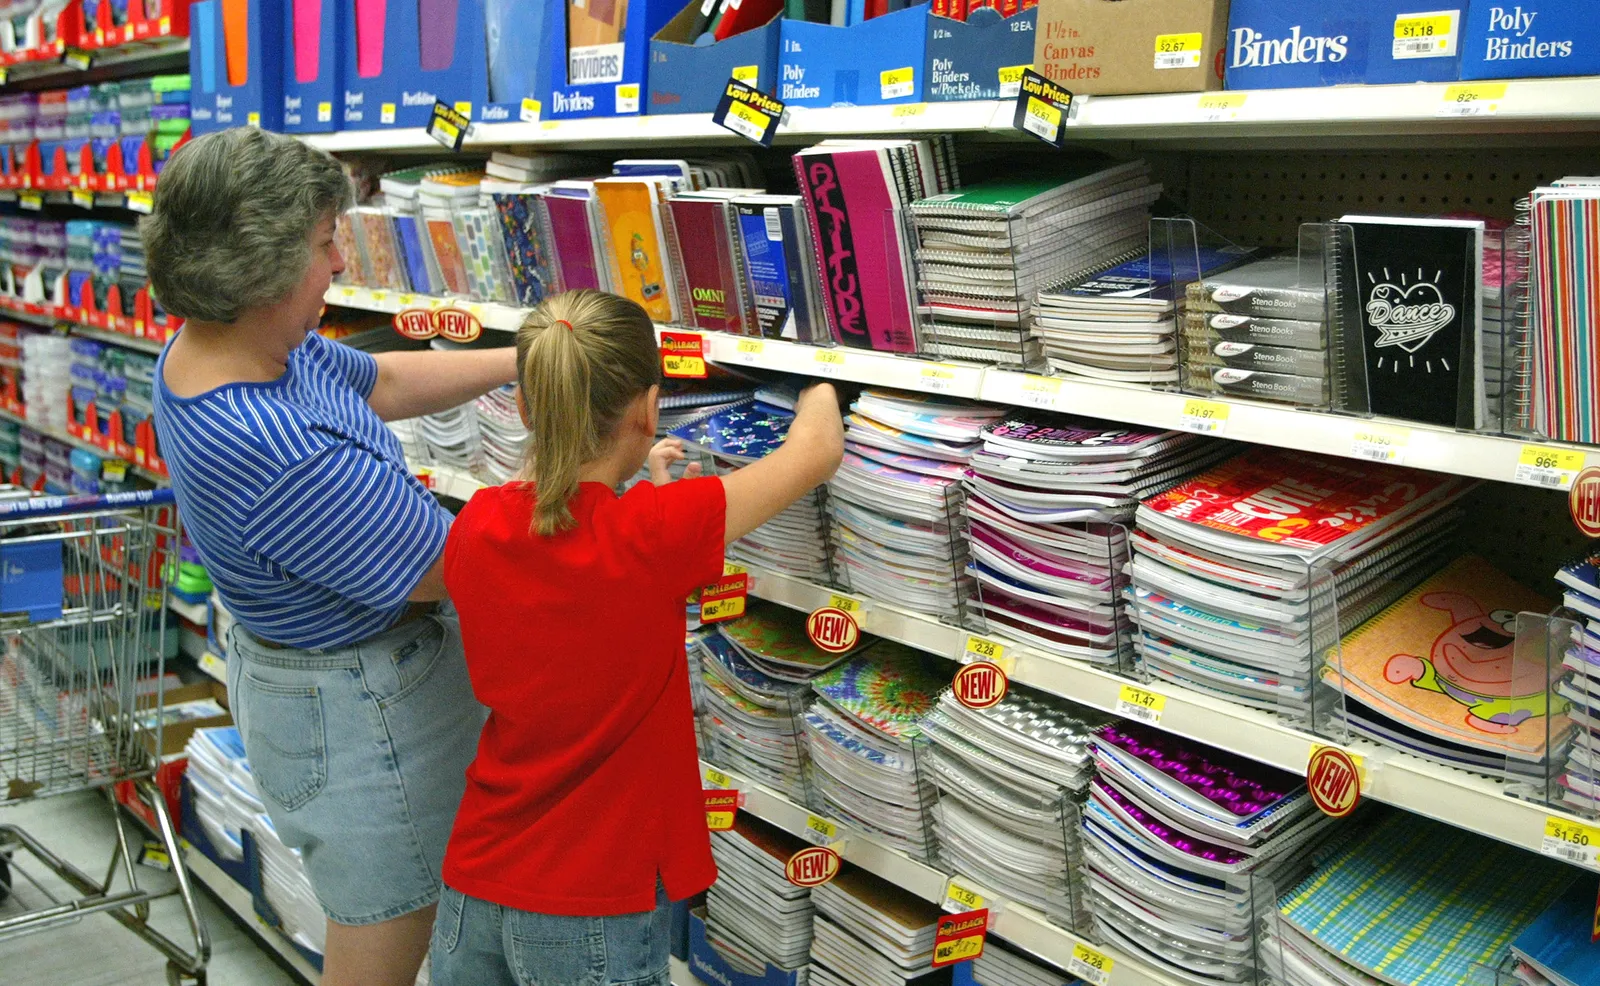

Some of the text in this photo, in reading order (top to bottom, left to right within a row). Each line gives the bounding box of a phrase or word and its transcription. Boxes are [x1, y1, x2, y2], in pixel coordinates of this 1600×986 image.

[1010, 22, 1019, 32] 12
[1488, 7, 1538, 37] Poly
[1403, 25, 1433, 37] $1.18
[1044, 43, 1094, 60] Canvas
[1160, 42, 1185, 53] $2.67
[1230, 25, 1348, 68] Binders
[1483, 37, 1573, 61] Binders
[571, 55, 619, 79] DIVIDERS
[783, 65, 805, 84] Poly
[932, 59, 953, 74] Poly
[1044, 63, 1101, 81] Binders
[932, 71, 969, 83] Binders
[782, 84, 820, 99] Binders
[931, 82, 980, 95] w/Pockets
[1023, 76, 1042, 95] Low
[1042, 83, 1070, 105] Prices
[553, 91, 594, 113] Dividers
[727, 84, 750, 101] Low
[749, 92, 782, 113] Prices
[1456, 93, 1479, 103] 82¢
[1032, 106, 1050, 121] $2.67
[692, 287, 725, 303] OMNI
[1252, 298, 1296, 308] Steno Books
[1367, 300, 1443, 325] Dance
[438, 312, 472, 338] NEW!
[1249, 324, 1294, 335] Steno Books
[1254, 352, 1274, 361] Steno
[1252, 380, 1296, 392] Steno Books
[1190, 407, 1214, 418] $1.97
[1535, 457, 1558, 469] 96¢
[1232, 477, 1336, 521] CUTIE
[814, 614, 849, 646] NEW!
[975, 643, 994, 656] $2.28
[960, 670, 997, 700] NEW!
[1131, 693, 1155, 707] $1.47
[1312, 754, 1355, 809] NEW!
[1554, 828, 1589, 846] $1.50
[793, 852, 829, 880] NEW!
[1081, 953, 1103, 970] $2.28
